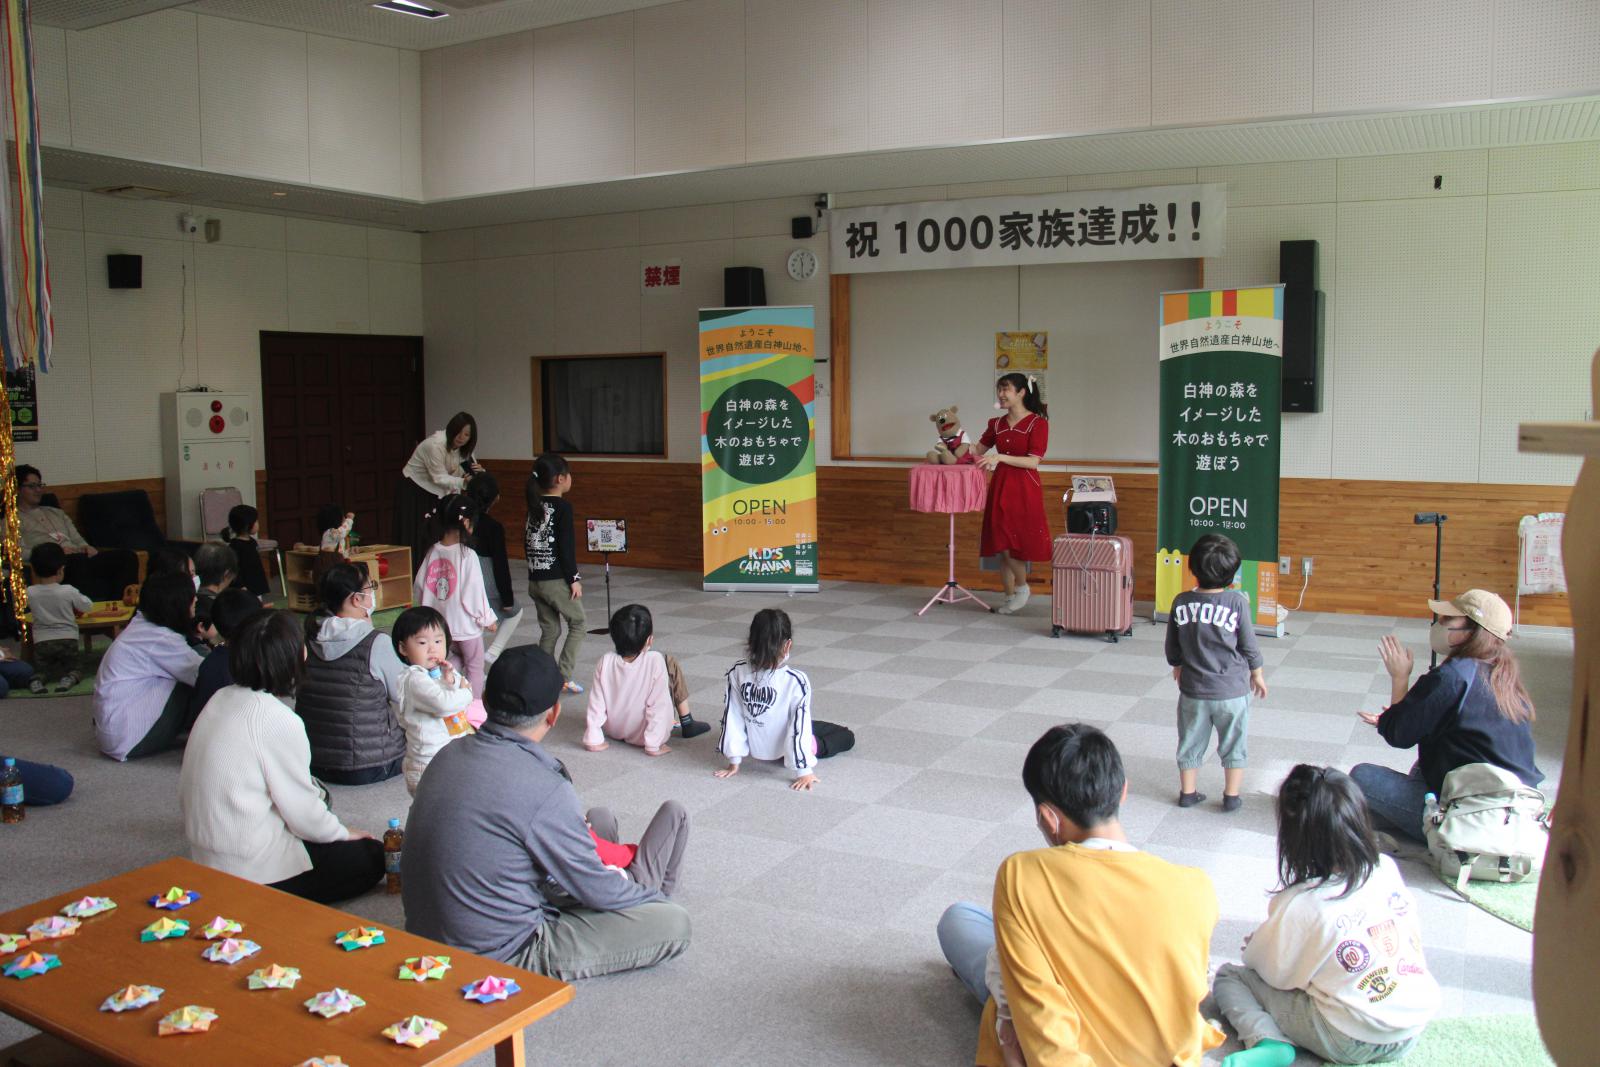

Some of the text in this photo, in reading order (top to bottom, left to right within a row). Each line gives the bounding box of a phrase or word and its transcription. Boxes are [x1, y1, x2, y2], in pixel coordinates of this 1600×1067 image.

[845, 221, 880, 259] 祝
[644, 265, 681, 288] 禁煙
[740, 328, 775, 338] ようこそ
[1204, 319, 1242, 331] ようこそ
[706, 340, 808, 356] 世界自然遺産白神山地へ
[1169, 334, 1280, 353] 世界自然遺産白神山地へ
[1183, 381, 1258, 399] 白神の森を
[726, 398, 789, 412] 白神の森を
[1179, 406, 1262, 423] イメージした
[723, 416, 793, 430] イメージした
[714, 435, 803, 449] 木のおもちゃで
[1172, 430, 1270, 447] 木のおもちゃで
[738, 453, 777, 467] 遊ぼう
[1195, 454, 1240, 472] 遊ぼう
[733, 500, 786, 515] OPEN
[1189, 496, 1248, 518] OPEN
[1190, 519, 1214, 528] 10:00
[739, 559, 793, 573] CARAVAN
[1175, 602, 1238, 632] OYOUS
